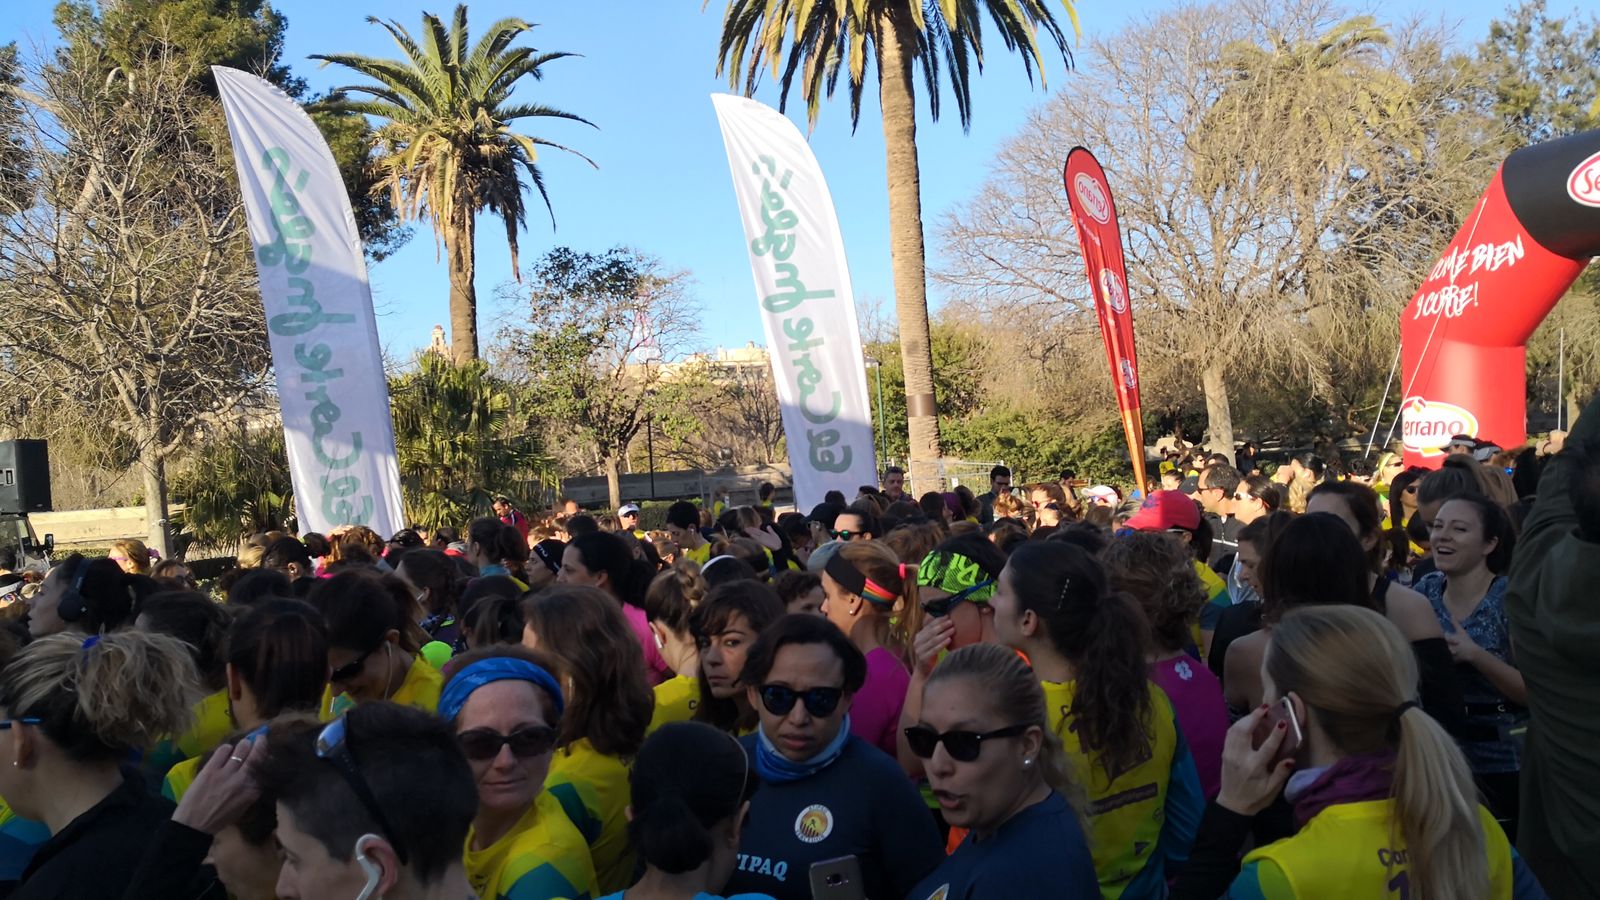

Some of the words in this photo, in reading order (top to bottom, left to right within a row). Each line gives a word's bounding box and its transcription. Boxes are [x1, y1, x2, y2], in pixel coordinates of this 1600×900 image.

[1469, 233, 1524, 275] BIEN
[1422, 281, 1479, 318] CORRE!
[1403, 420, 1464, 436] errano
